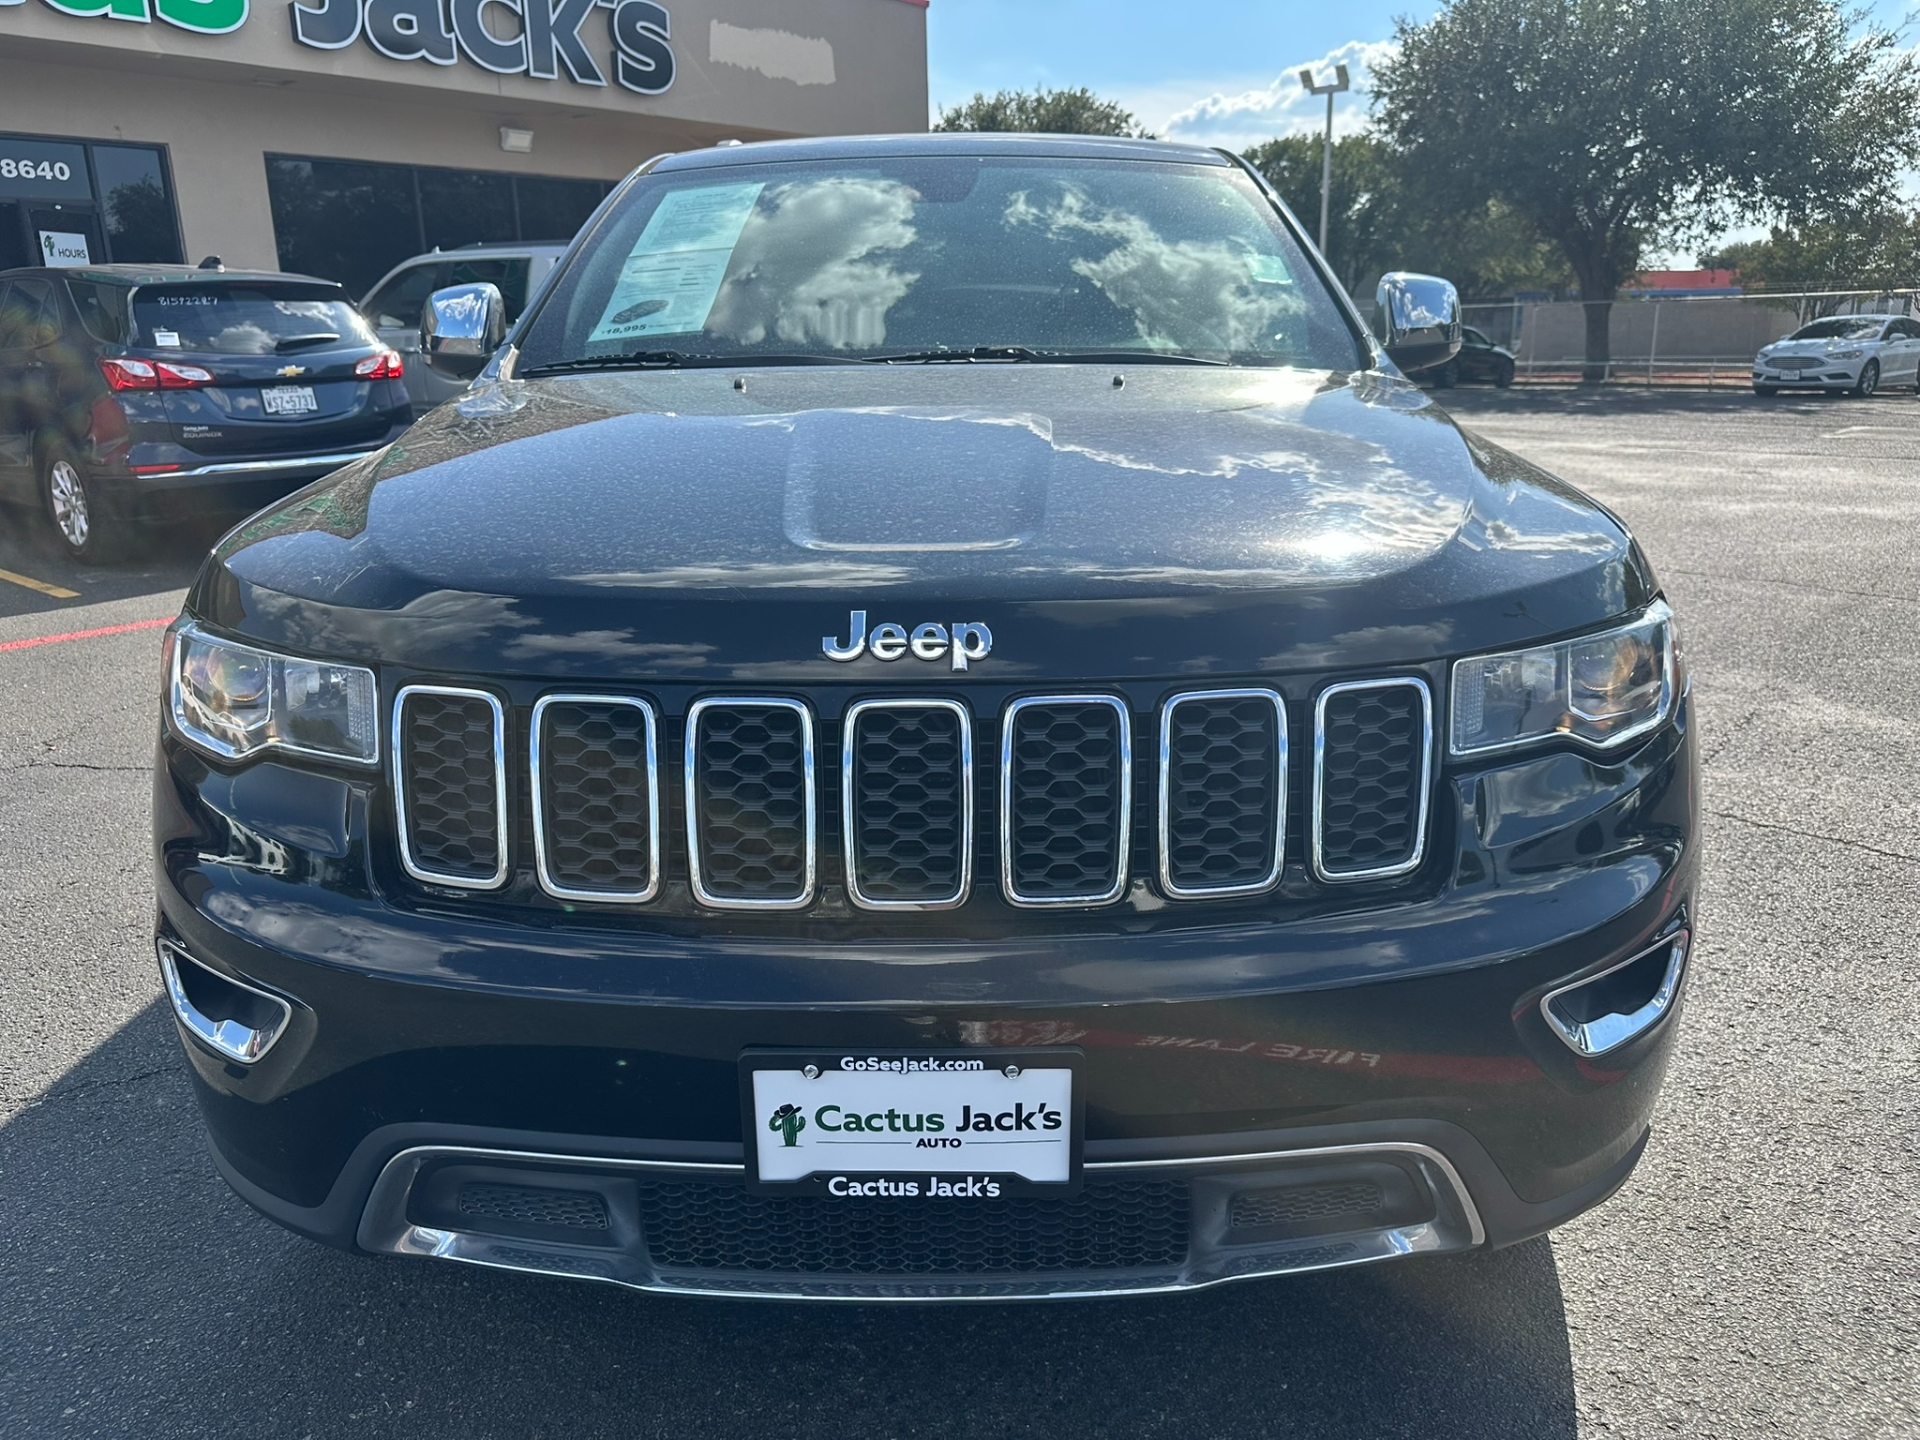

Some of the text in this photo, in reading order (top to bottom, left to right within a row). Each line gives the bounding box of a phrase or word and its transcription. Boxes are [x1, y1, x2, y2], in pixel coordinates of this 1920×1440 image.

[294, 0, 677, 95] acks
[0, 158, 71, 181] 8640
[58, 248, 87, 259] HOURS
[822, 610, 993, 672] Jeep
[840, 1056, 984, 1074] GoSeeJack.com
[814, 1102, 1063, 1133] Cactus Jack's
[915, 1138, 963, 1149] AUTO
[827, 1176, 1001, 1198] Cactus Jack's
